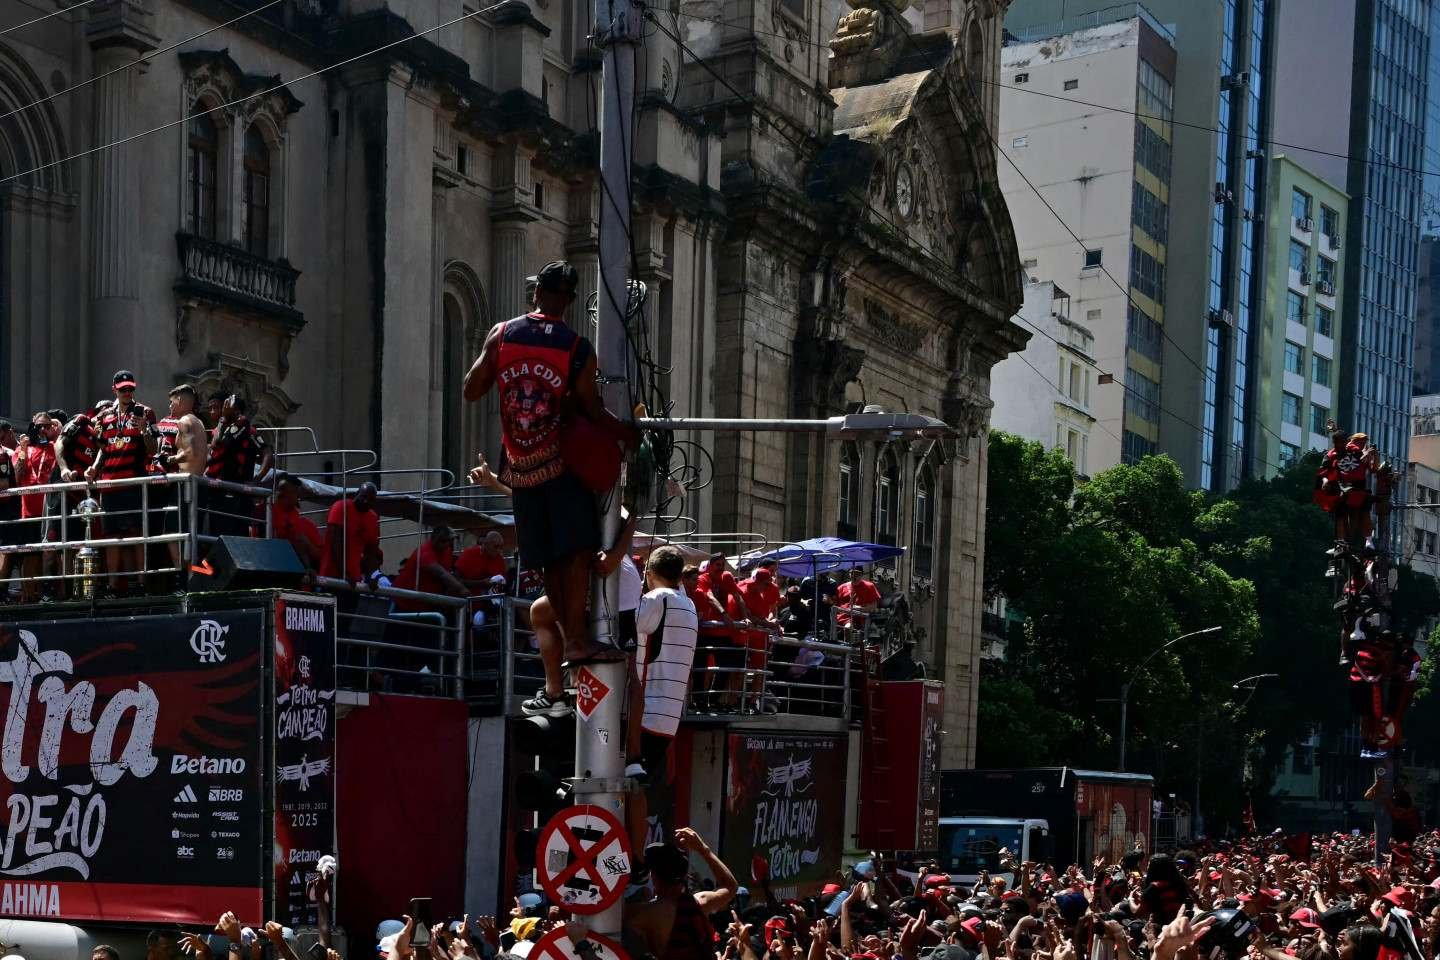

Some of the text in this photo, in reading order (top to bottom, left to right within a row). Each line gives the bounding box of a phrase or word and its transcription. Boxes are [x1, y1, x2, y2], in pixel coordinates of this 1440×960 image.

[533, 363, 563, 388] CDD
[285, 606, 325, 633] BRAHMA
[289, 684, 317, 707] Tetra
[277, 704, 328, 741] CAMPEÃO
[170, 754, 246, 775] Betano
[220, 788, 243, 802] BRB
[1032, 785, 1046, 793] 257
[291, 813, 318, 827] 2025
[752, 797, 818, 848] FLAMENGO
[177, 845, 194, 856] abc
[288, 848, 321, 863] Betano
[768, 841, 801, 881] Tetra
